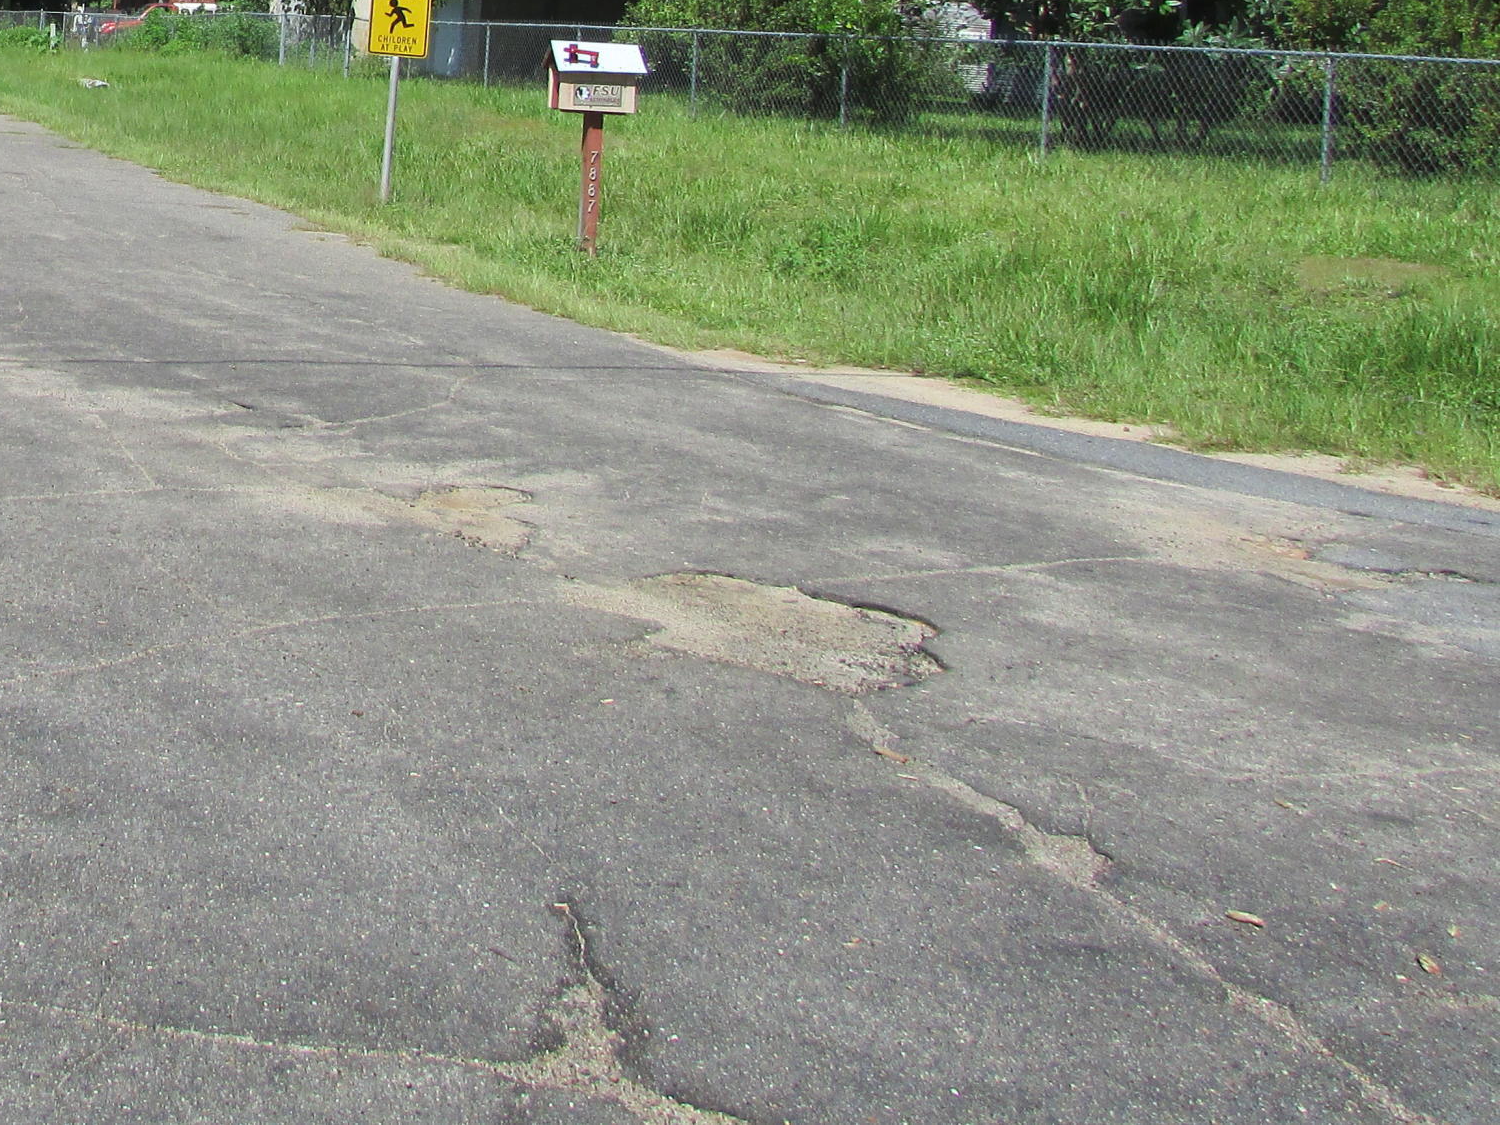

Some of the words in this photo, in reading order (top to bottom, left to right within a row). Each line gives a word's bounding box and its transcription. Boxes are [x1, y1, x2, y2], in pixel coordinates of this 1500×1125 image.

[378, 35, 417, 45] CHILDREN
[393, 45, 412, 53] PLAY
[593, 86, 620, 96] FSU
[587, 150, 599, 212] 7887
